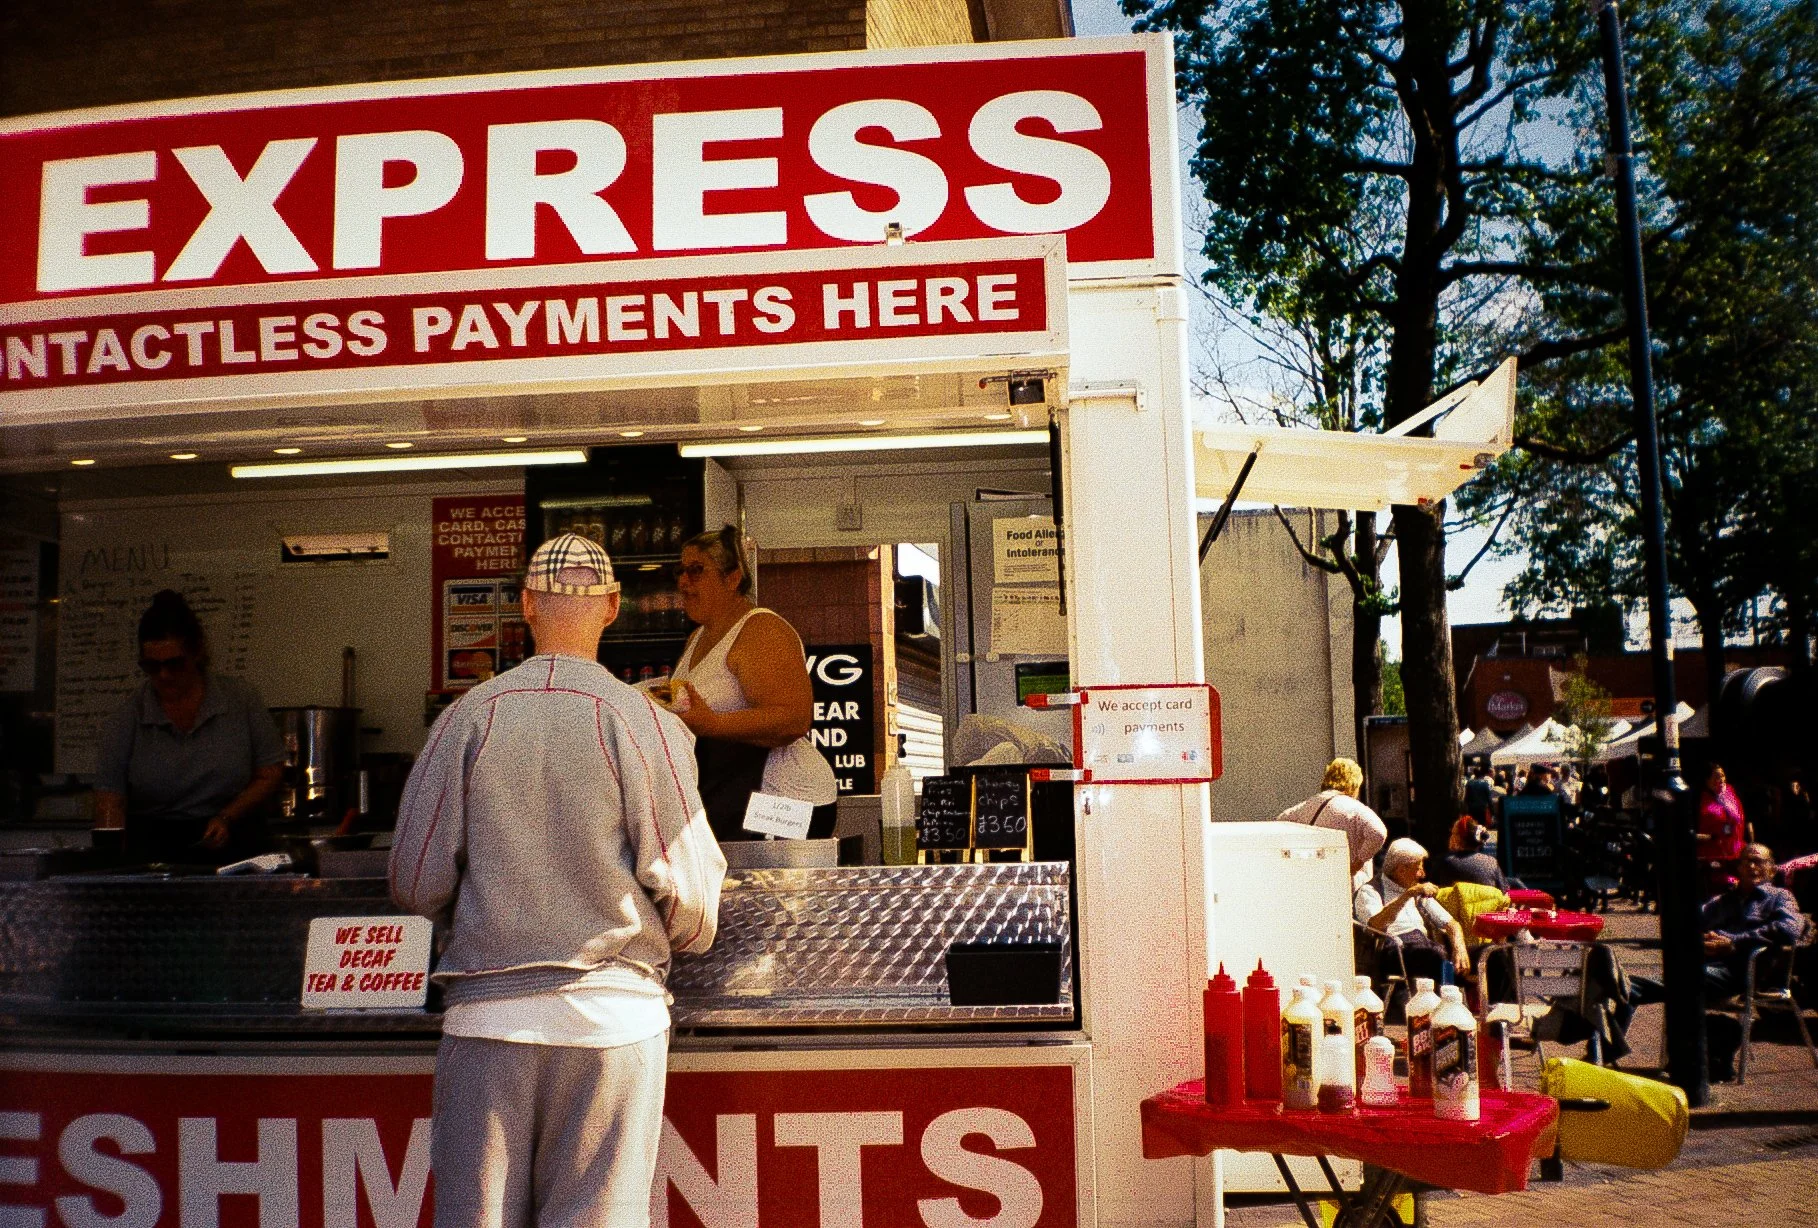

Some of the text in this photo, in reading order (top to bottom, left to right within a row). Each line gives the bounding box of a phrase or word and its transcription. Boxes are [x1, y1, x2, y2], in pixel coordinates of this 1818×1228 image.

[36, 90, 1111, 293] EXPRESS
[0, 274, 1019, 380] NTACTLESS PAYMENTS HERE
[451, 507, 476, 520] WE
[1007, 531, 1033, 540] Food
[81, 544, 169, 573] MENU
[457, 593, 488, 605] VISA
[450, 624, 493, 633] DISCOVER
[806, 654, 863, 685] G
[813, 701, 860, 721] EAR
[1098, 699, 1192, 713] We accept card
[807, 728, 848, 748] ND
[1124, 722, 1185, 735] payments
[835, 778, 853, 790] LE
[754, 811, 774, 822] Steak
[336, 926, 403, 945] WE SELL
[340, 949, 396, 969] DECAF
[307, 973, 425, 993] TEA & COFFEE
